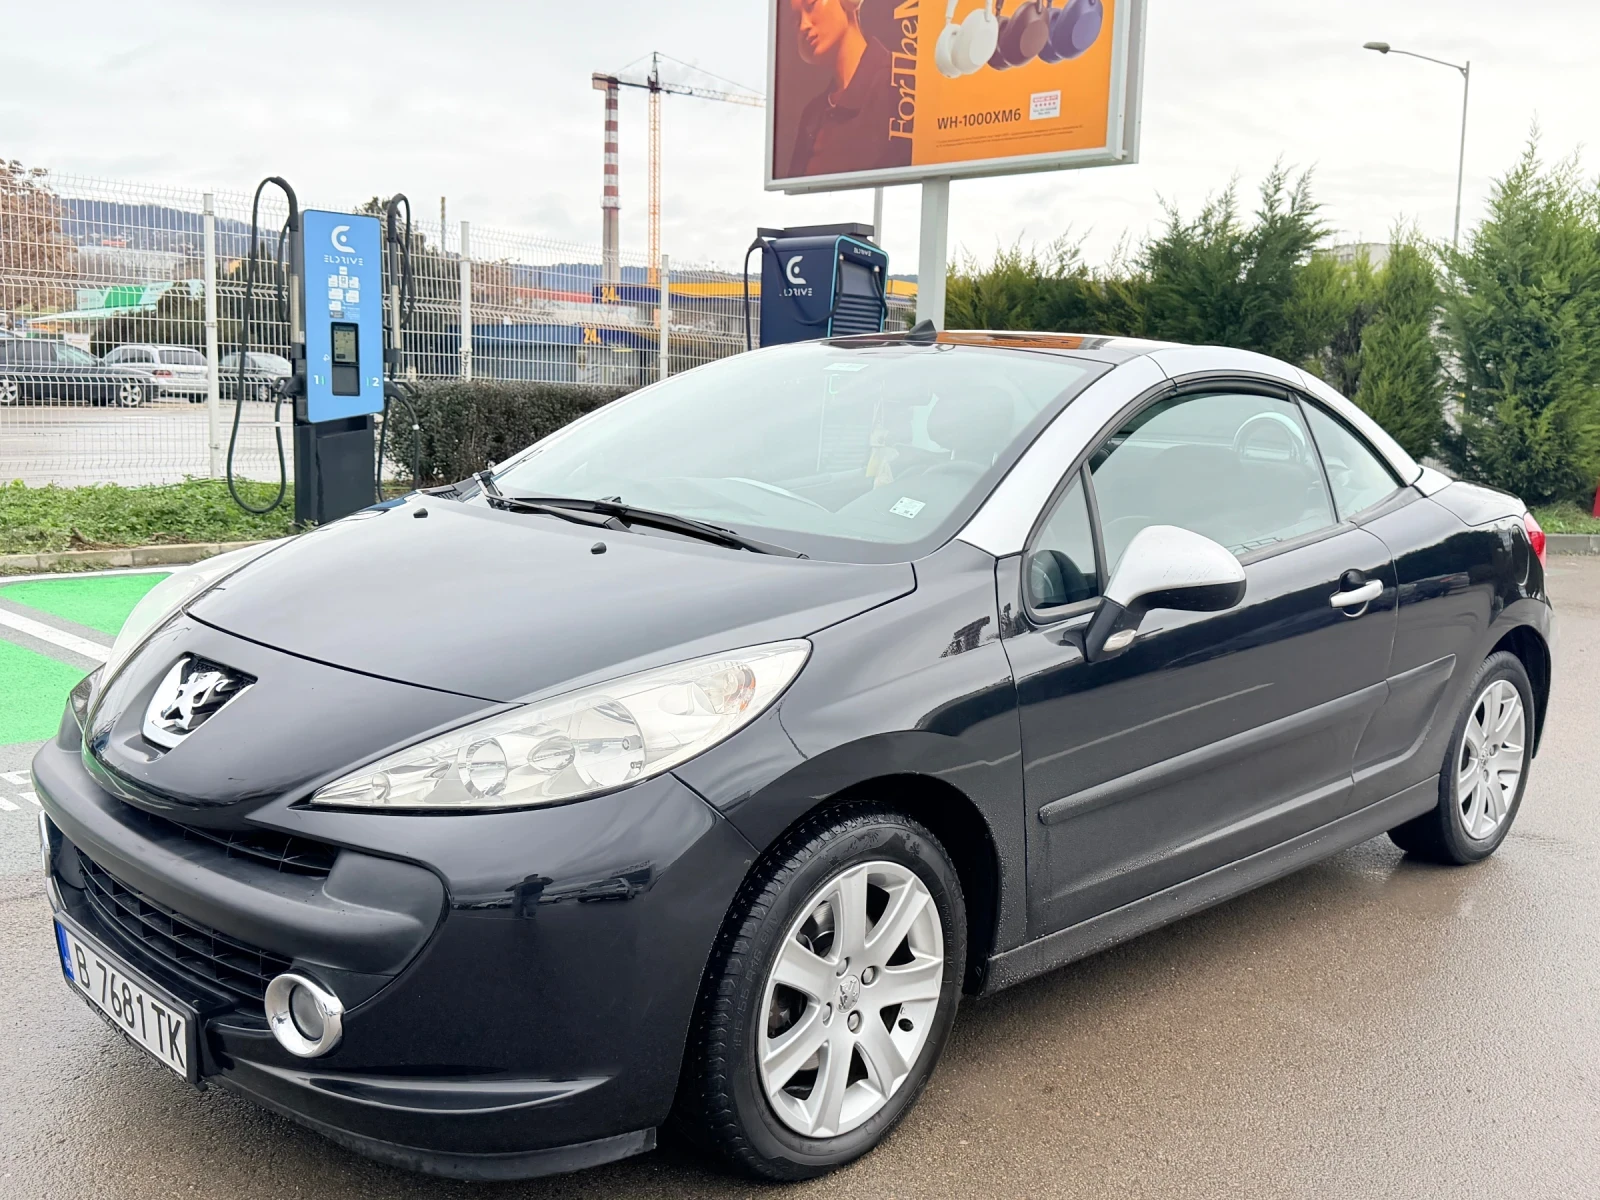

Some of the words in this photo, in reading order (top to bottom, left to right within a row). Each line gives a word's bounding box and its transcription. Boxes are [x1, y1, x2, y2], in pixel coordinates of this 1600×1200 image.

[937, 108, 1021, 130] WH-1000XM6
[323, 254, 364, 266] ELDRIVE
[778, 287, 813, 297] LDRIVE
[313, 375, 320, 385] 1
[371, 377, 380, 387] 2
[74, 942, 91, 989] B
[96, 960, 147, 1040] 7681
[151, 1001, 185, 1069] TK
